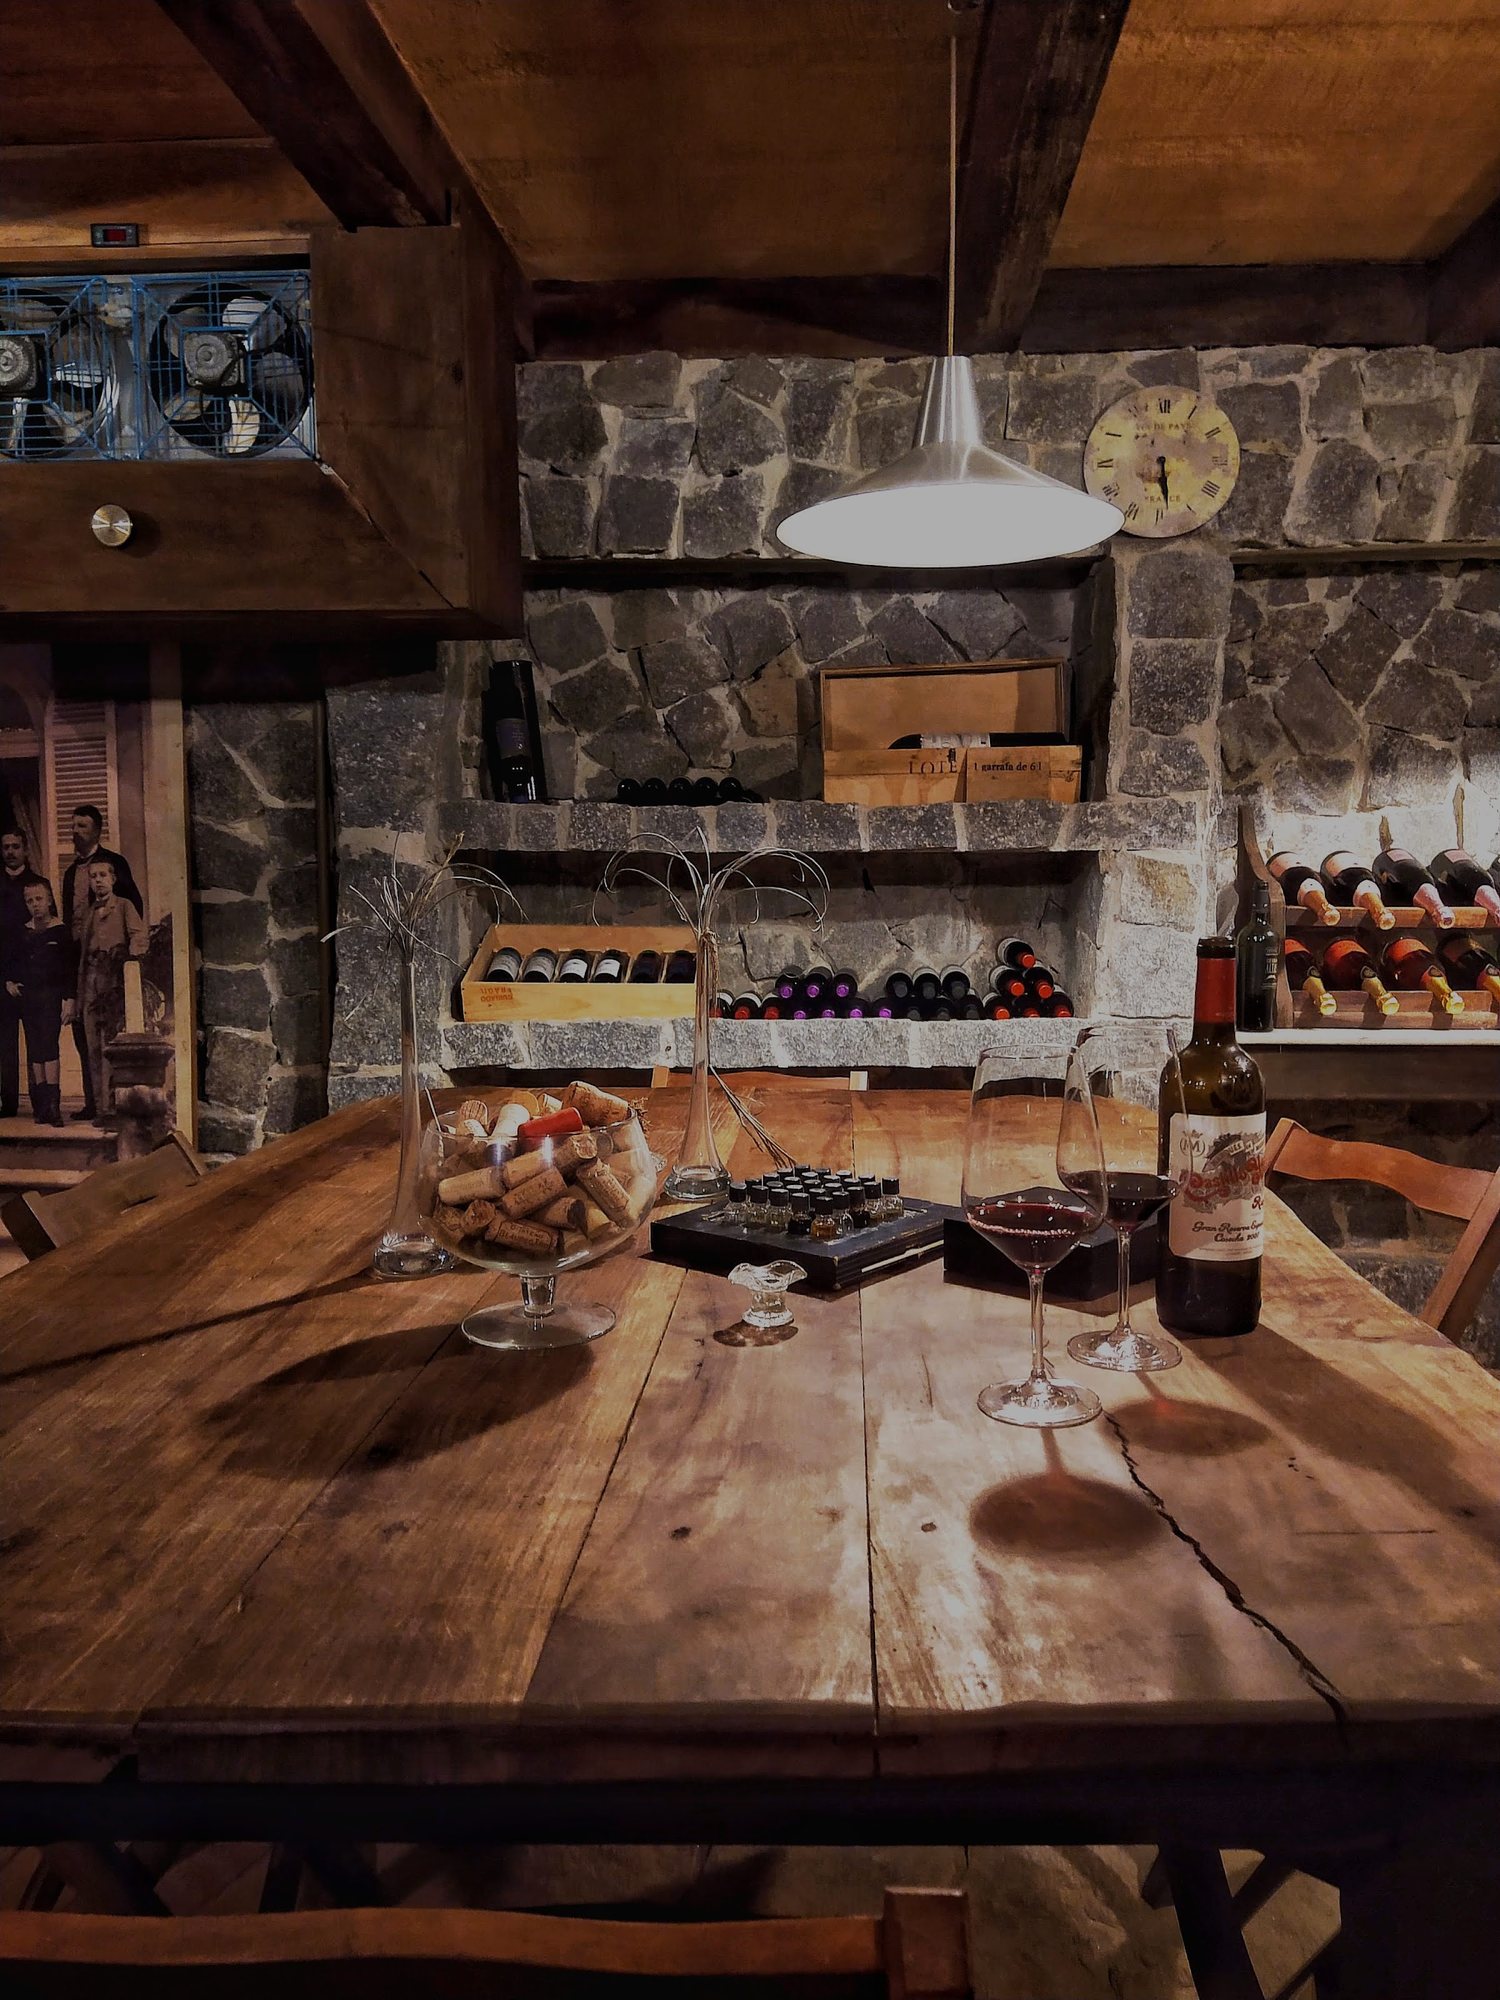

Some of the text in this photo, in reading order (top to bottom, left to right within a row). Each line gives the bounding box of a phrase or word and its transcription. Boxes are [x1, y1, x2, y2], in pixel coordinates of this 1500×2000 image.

[981, 761, 1014, 772] garrafa
[1016, 761, 1027, 771] de
[1192, 1221, 1217, 1232] Gran
